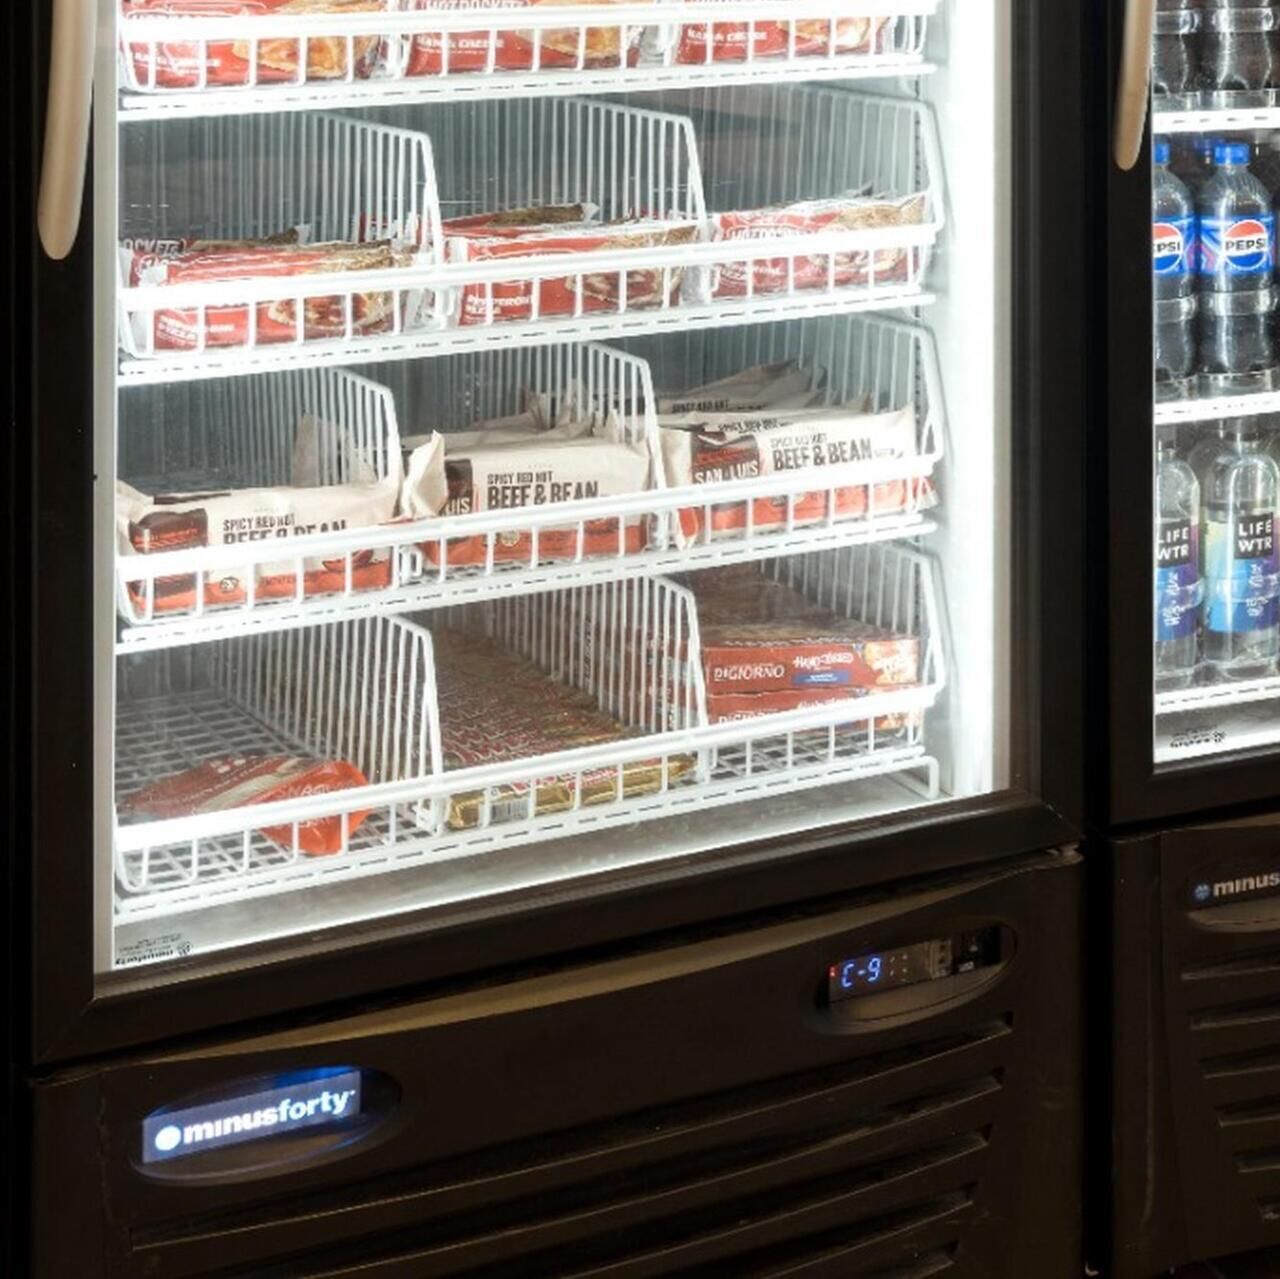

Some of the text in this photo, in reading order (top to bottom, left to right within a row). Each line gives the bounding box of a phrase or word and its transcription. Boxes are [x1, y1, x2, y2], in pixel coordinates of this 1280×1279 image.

[1225, 240, 1266, 252] PEPSI
[773, 438, 873, 471] BEEF & BEAN
[487, 483, 531, 511] BEEF
[1238, 520, 1272, 537] LIFE
[1157, 546, 1189, 560] WTR
[1238, 539, 1272, 553] WTR
[183, 1091, 348, 1144] minusforty
